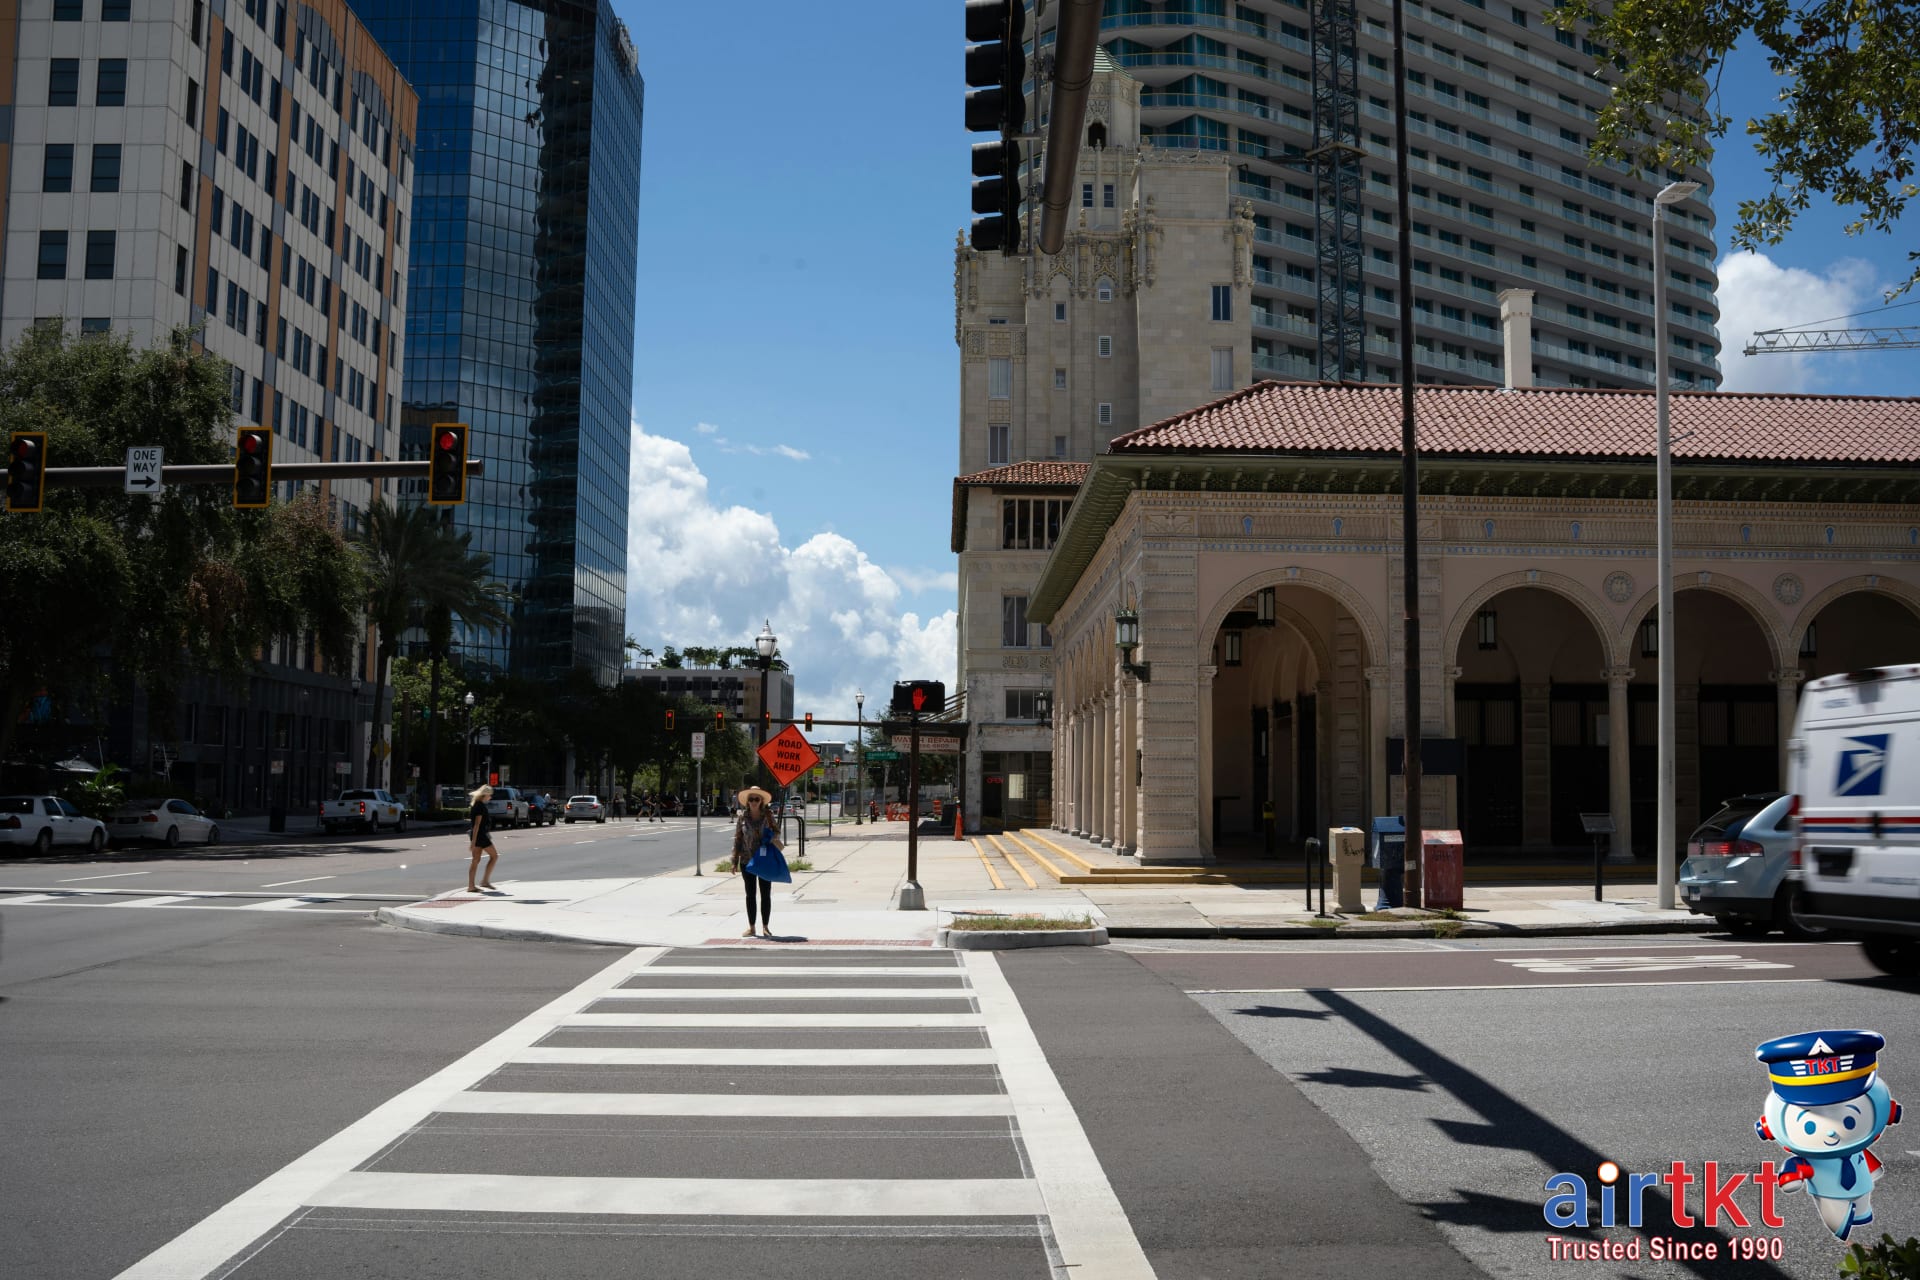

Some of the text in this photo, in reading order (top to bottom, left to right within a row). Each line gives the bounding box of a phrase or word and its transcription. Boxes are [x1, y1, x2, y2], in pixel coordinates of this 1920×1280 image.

[133, 449, 157, 461] ONE
[133, 462, 157, 473] WAY
[777, 738, 803, 750] ROAD
[776, 750, 801, 762] WORK
[773, 762, 801, 773] AHEAD
